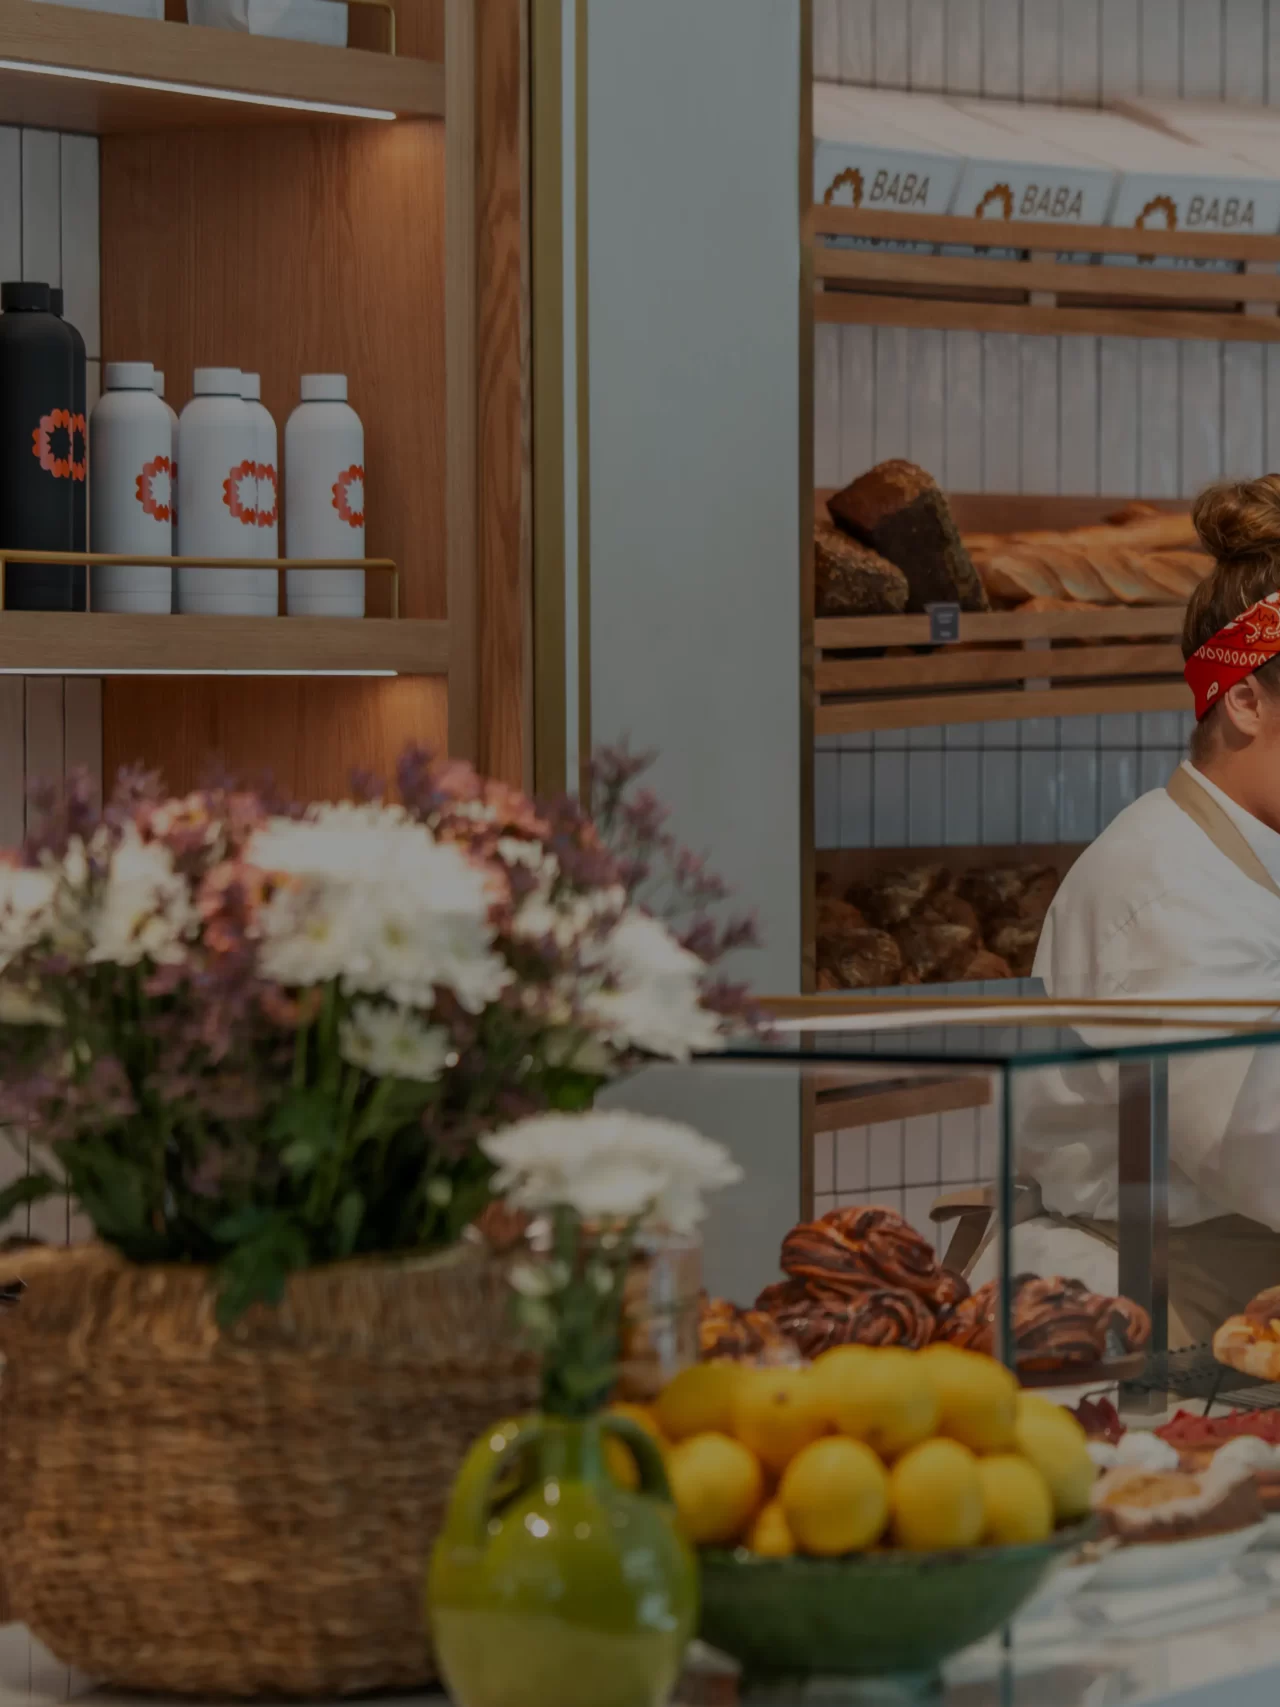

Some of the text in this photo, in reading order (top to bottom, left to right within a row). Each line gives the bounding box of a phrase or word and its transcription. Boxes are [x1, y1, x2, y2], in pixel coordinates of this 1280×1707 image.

[869, 170, 930, 207] BABA
[1019, 185, 1083, 219] BABA
[1186, 196, 1256, 226] BABA
